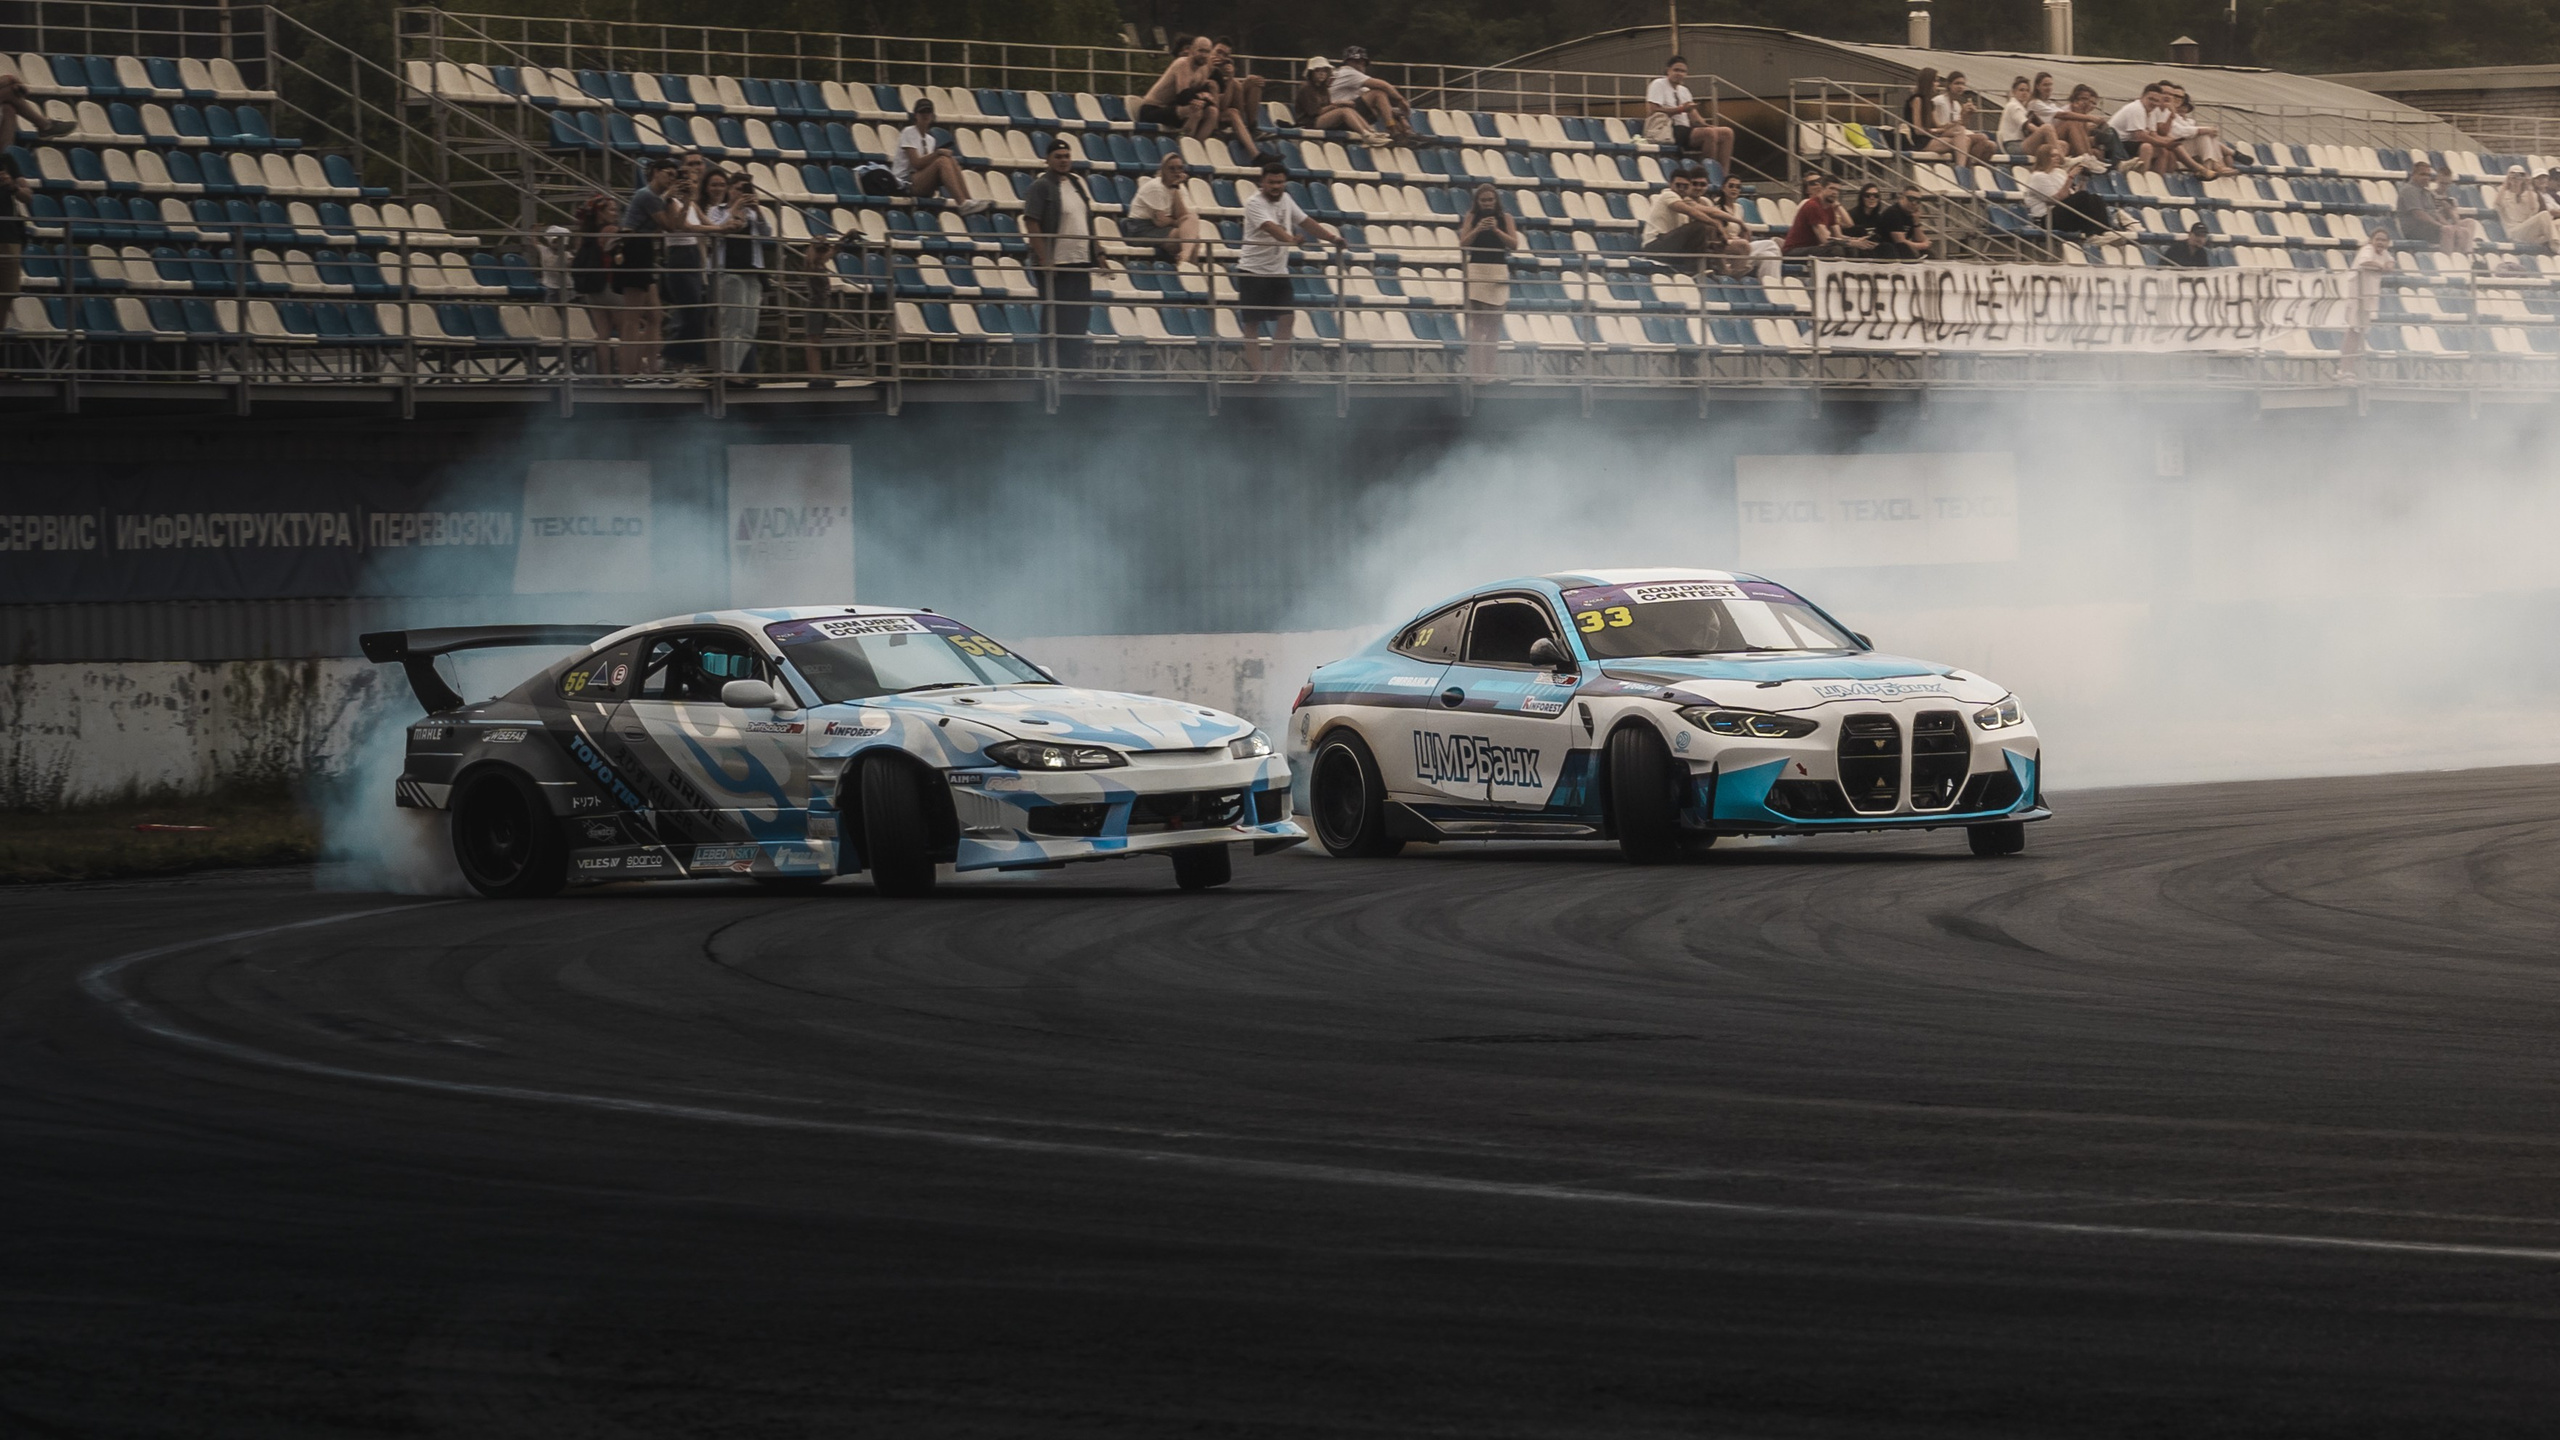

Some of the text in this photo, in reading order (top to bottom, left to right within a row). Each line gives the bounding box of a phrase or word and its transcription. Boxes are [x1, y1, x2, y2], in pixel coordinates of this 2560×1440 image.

[0, 511, 514, 550] СЕРВИС ИНФРАСТРУКТУРА ПЕРЕВОЗКИ
[1637, 583, 1730, 595] ADM DRIFT
[1641, 590, 1736, 601] CONTEST
[823, 617, 908, 630] ADM DRIFT
[1576, 606, 1633, 633] 33
[830, 624, 918, 636] CONTEST
[1414, 628, 1435, 648] 33
[947, 634, 1006, 656] 56
[564, 671, 589, 692] 56
[1522, 697, 1562, 713] KINFOREST
[413, 728, 442, 740] MAHLE
[824, 720, 883, 737] KINFOREST
[570, 735, 613, 783] TOYO
[1413, 730, 1542, 788] ЦМРБанк
[572, 795, 602, 809] ドリフト
[668, 769, 727, 832] BRIDE
[697, 846, 756, 860] LEBEDINSKY
[577, 854, 663, 869] VELES sparco
